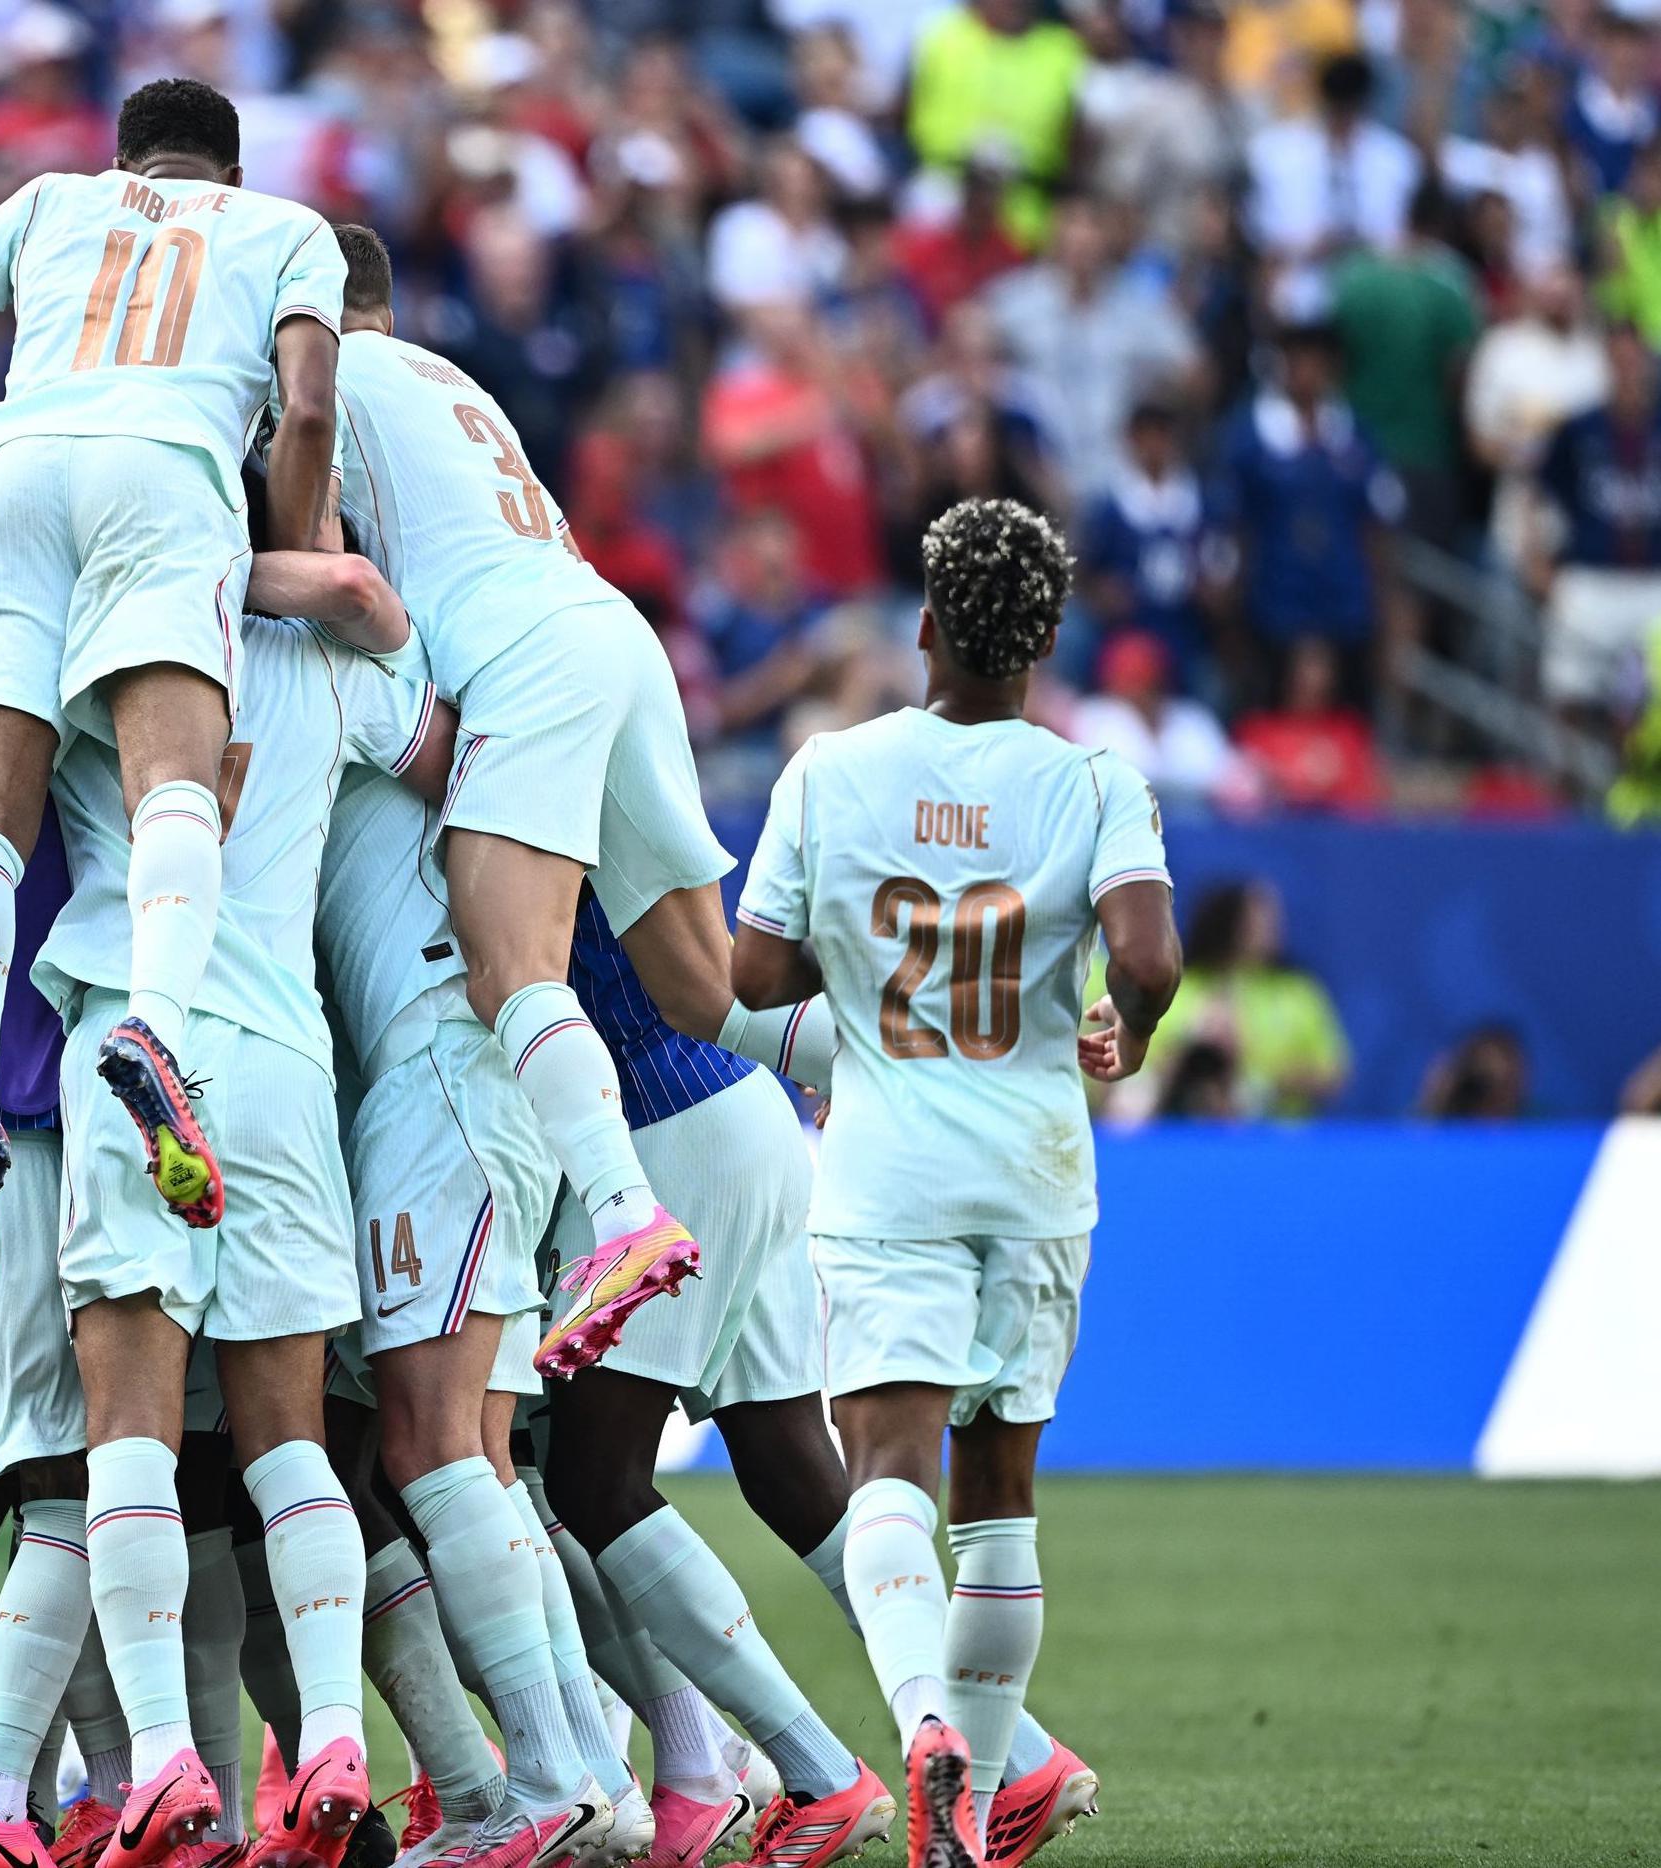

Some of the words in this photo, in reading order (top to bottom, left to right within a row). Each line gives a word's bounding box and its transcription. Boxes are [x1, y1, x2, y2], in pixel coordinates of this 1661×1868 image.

[120, 180, 232, 223] MBAPPE
[70, 226, 206, 371] 10
[452, 403, 554, 541] 3
[914, 799, 990, 850] DOUE
[141, 895, 191, 913] FFF
[871, 876, 1026, 1062] 20
[369, 1211, 423, 1294] 14
[508, 1538, 533, 1552] FF
[874, 1573, 931, 1597] FFF
[148, 1611, 181, 1625] FF
[294, 1597, 349, 1619] FFF
[957, 1667, 1015, 1686] FFF
